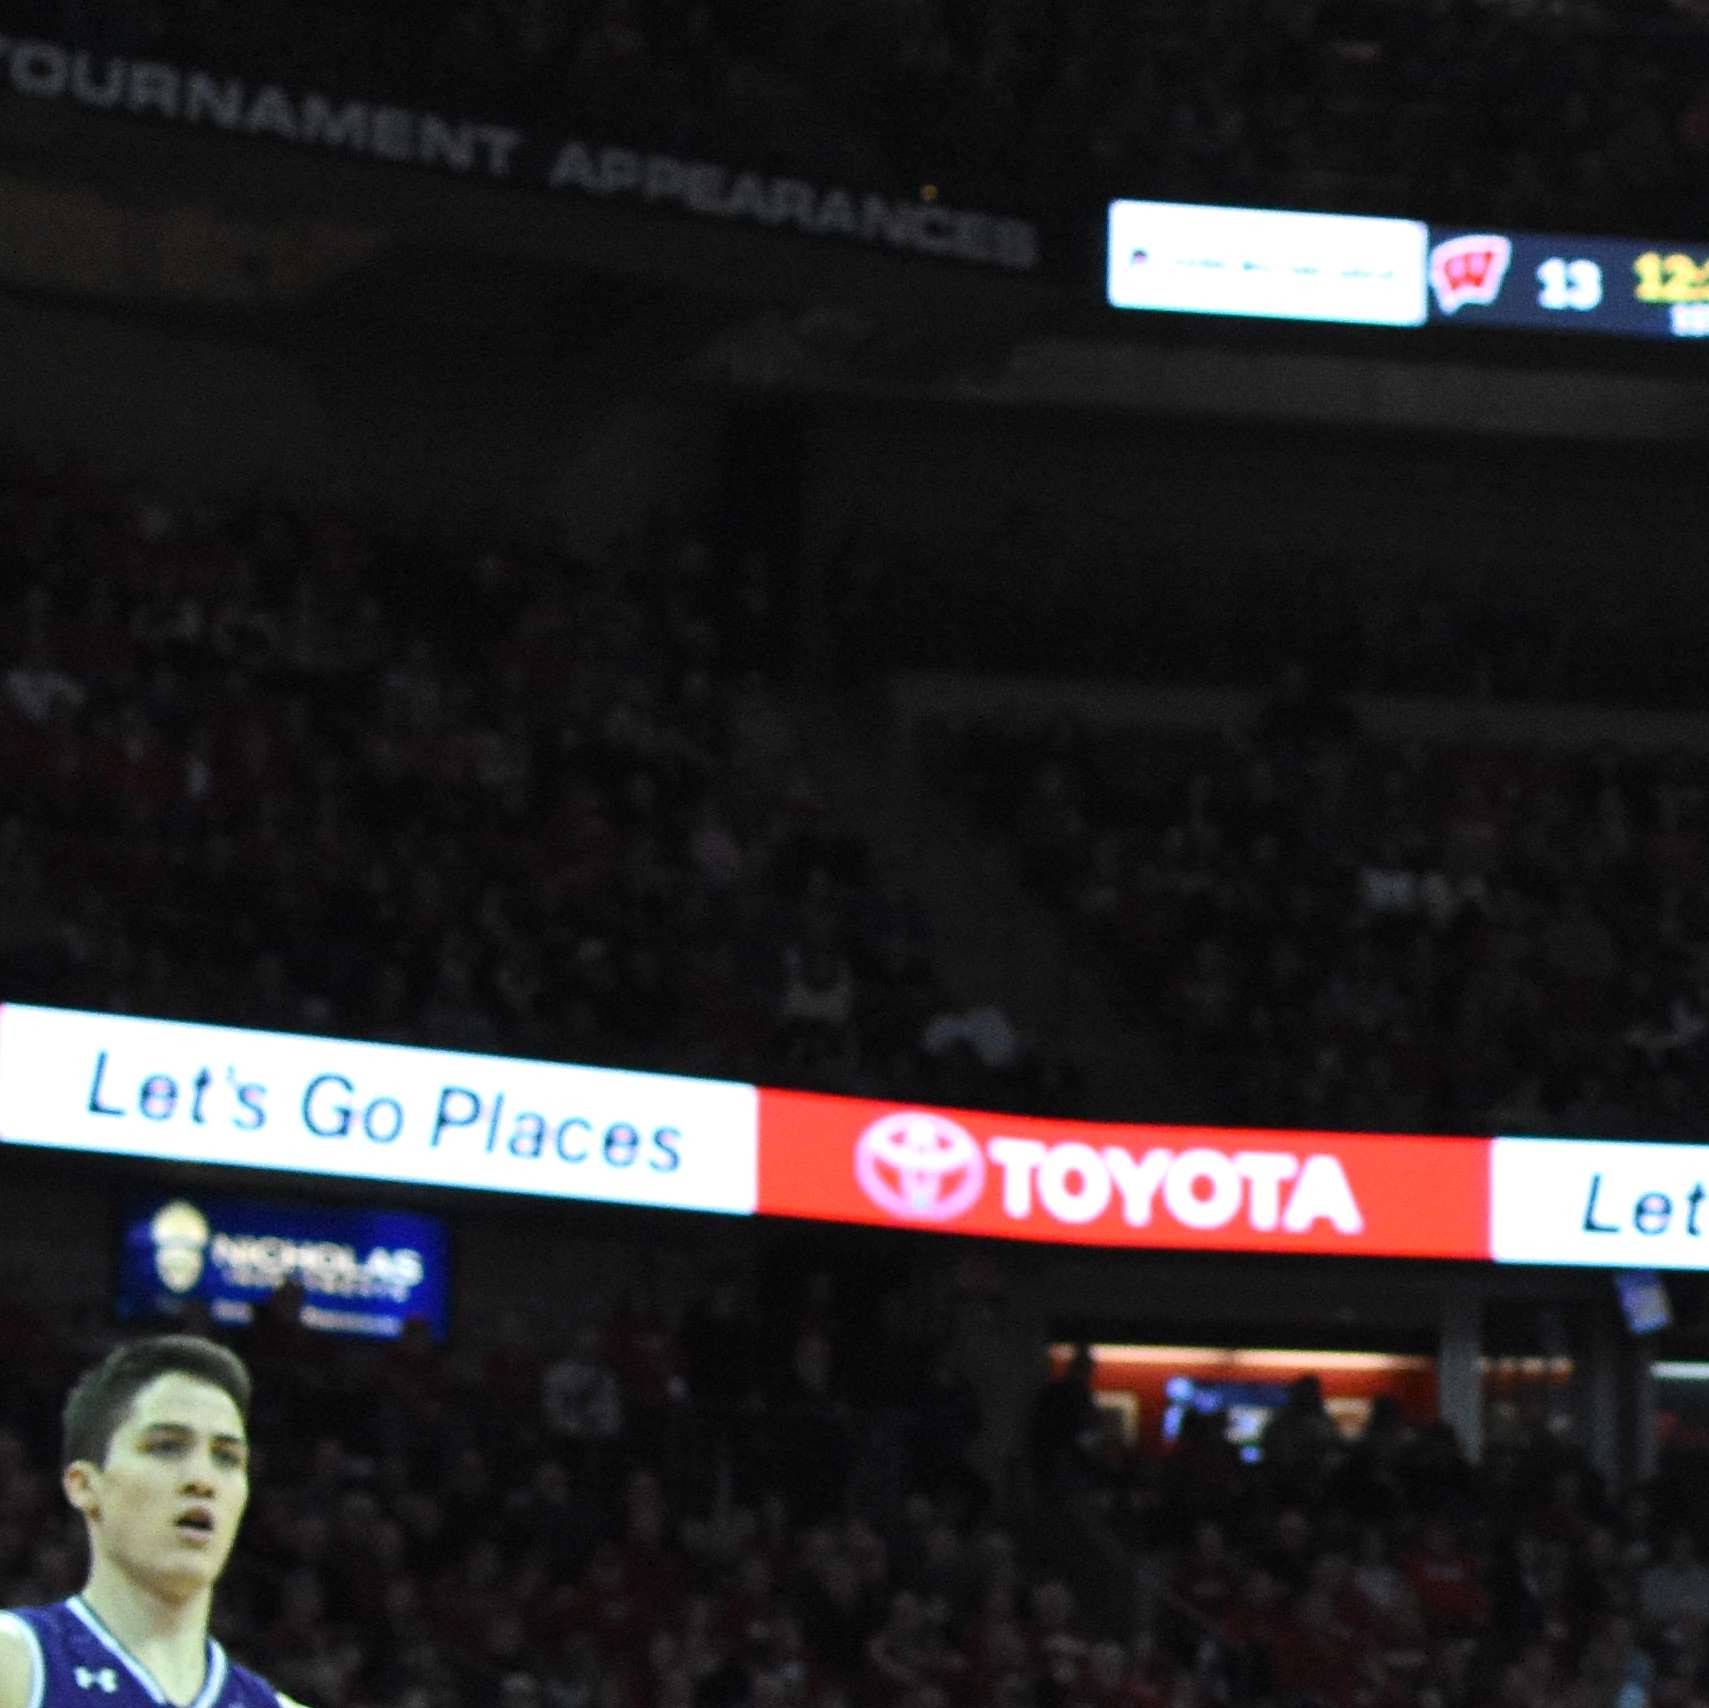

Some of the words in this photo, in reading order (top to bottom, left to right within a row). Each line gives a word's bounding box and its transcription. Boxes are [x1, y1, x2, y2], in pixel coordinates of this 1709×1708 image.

[0, 35, 518, 176] OURNAMENT
[1536, 257, 1603, 311] 13
[86, 1048, 270, 1131] Let's
[300, 1072, 405, 1145] Go
[429, 1085, 684, 1173] Places
[988, 1136, 1365, 1235] TOYOTA
